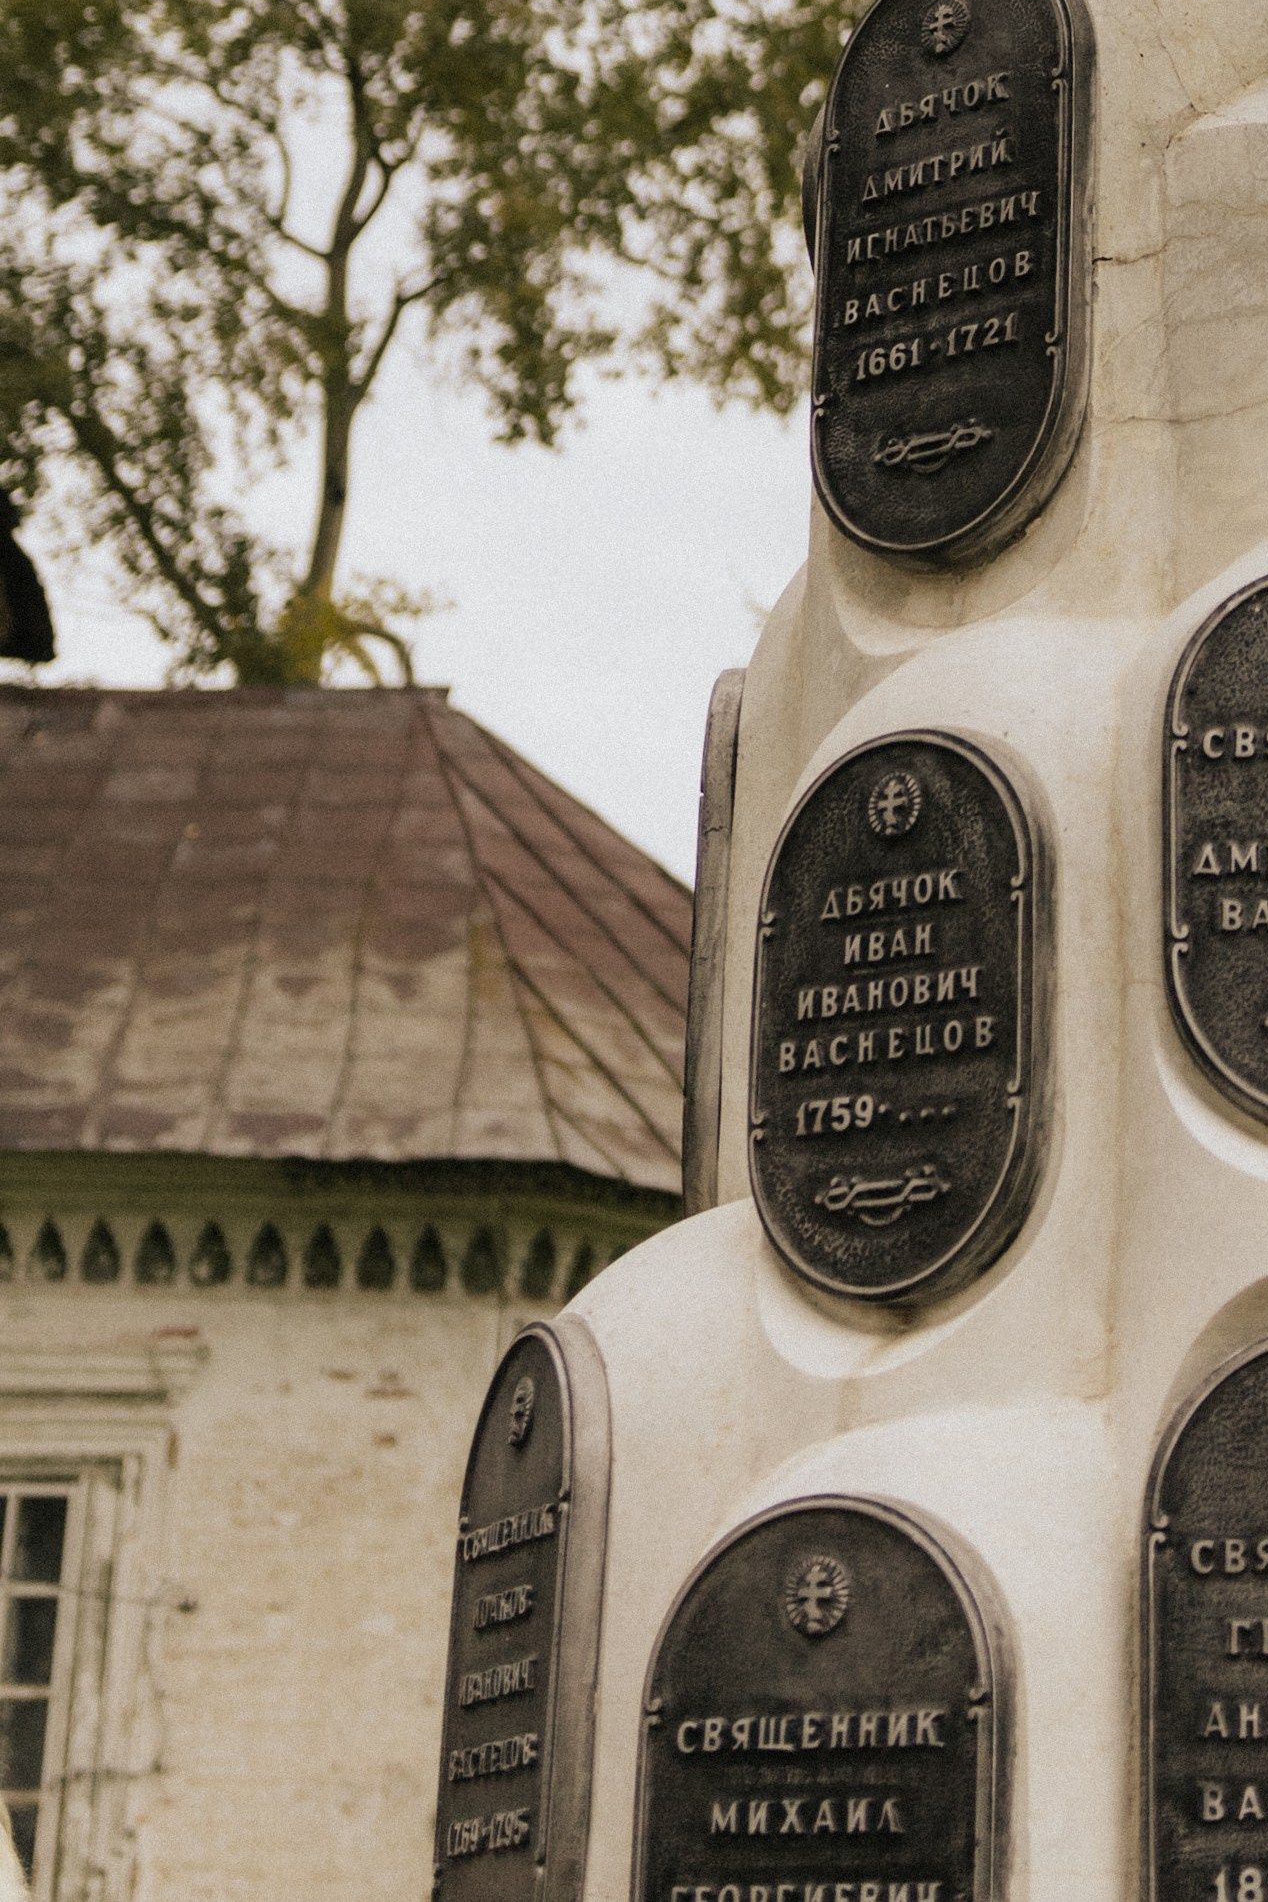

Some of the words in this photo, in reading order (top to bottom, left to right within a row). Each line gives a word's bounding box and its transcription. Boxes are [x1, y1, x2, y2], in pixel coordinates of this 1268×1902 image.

[862, 128, 1013, 202] ДМИТРИЙ
[846, 191, 1040, 265] ИГНАТЬЕВИЧ
[843, 250, 1033, 326] ВАСНЕЦОВ
[843, 923, 934, 965] ИВАН
[797, 966, 981, 1021] ИВАНОВИЧ
[779, 1015, 995, 1073] ВАСНЕЦОВ
[676, 1709, 946, 1753] СВЯЩЕННИК
[711, 1798, 904, 1835] МИХАИЛ
